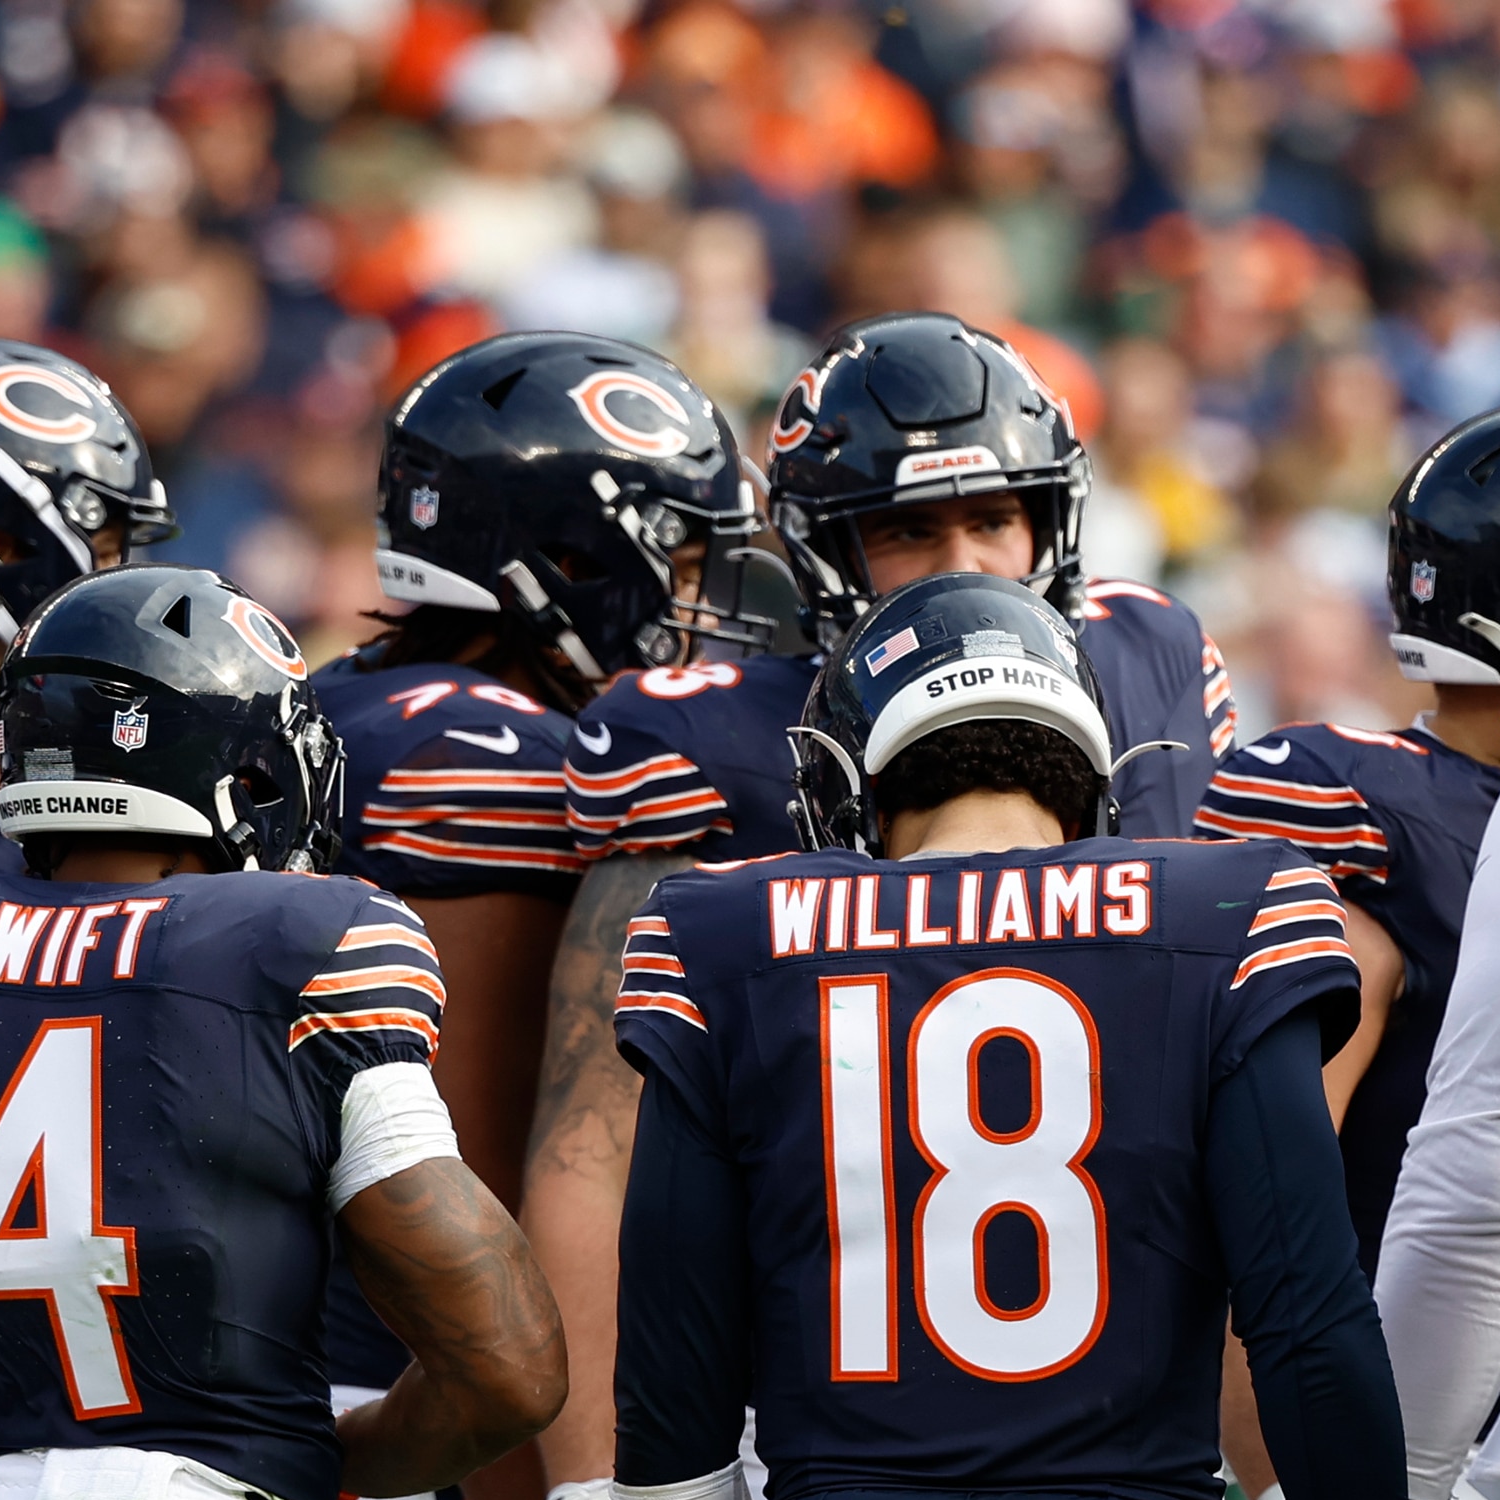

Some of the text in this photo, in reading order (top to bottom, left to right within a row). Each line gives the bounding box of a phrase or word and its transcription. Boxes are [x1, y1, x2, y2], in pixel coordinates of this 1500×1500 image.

[926, 666, 1062, 698] STOP HATE
[46, 796, 128, 815] CHANGE
[768, 860, 1151, 958] WILLIAMS
[818, 966, 1109, 1383] 18
